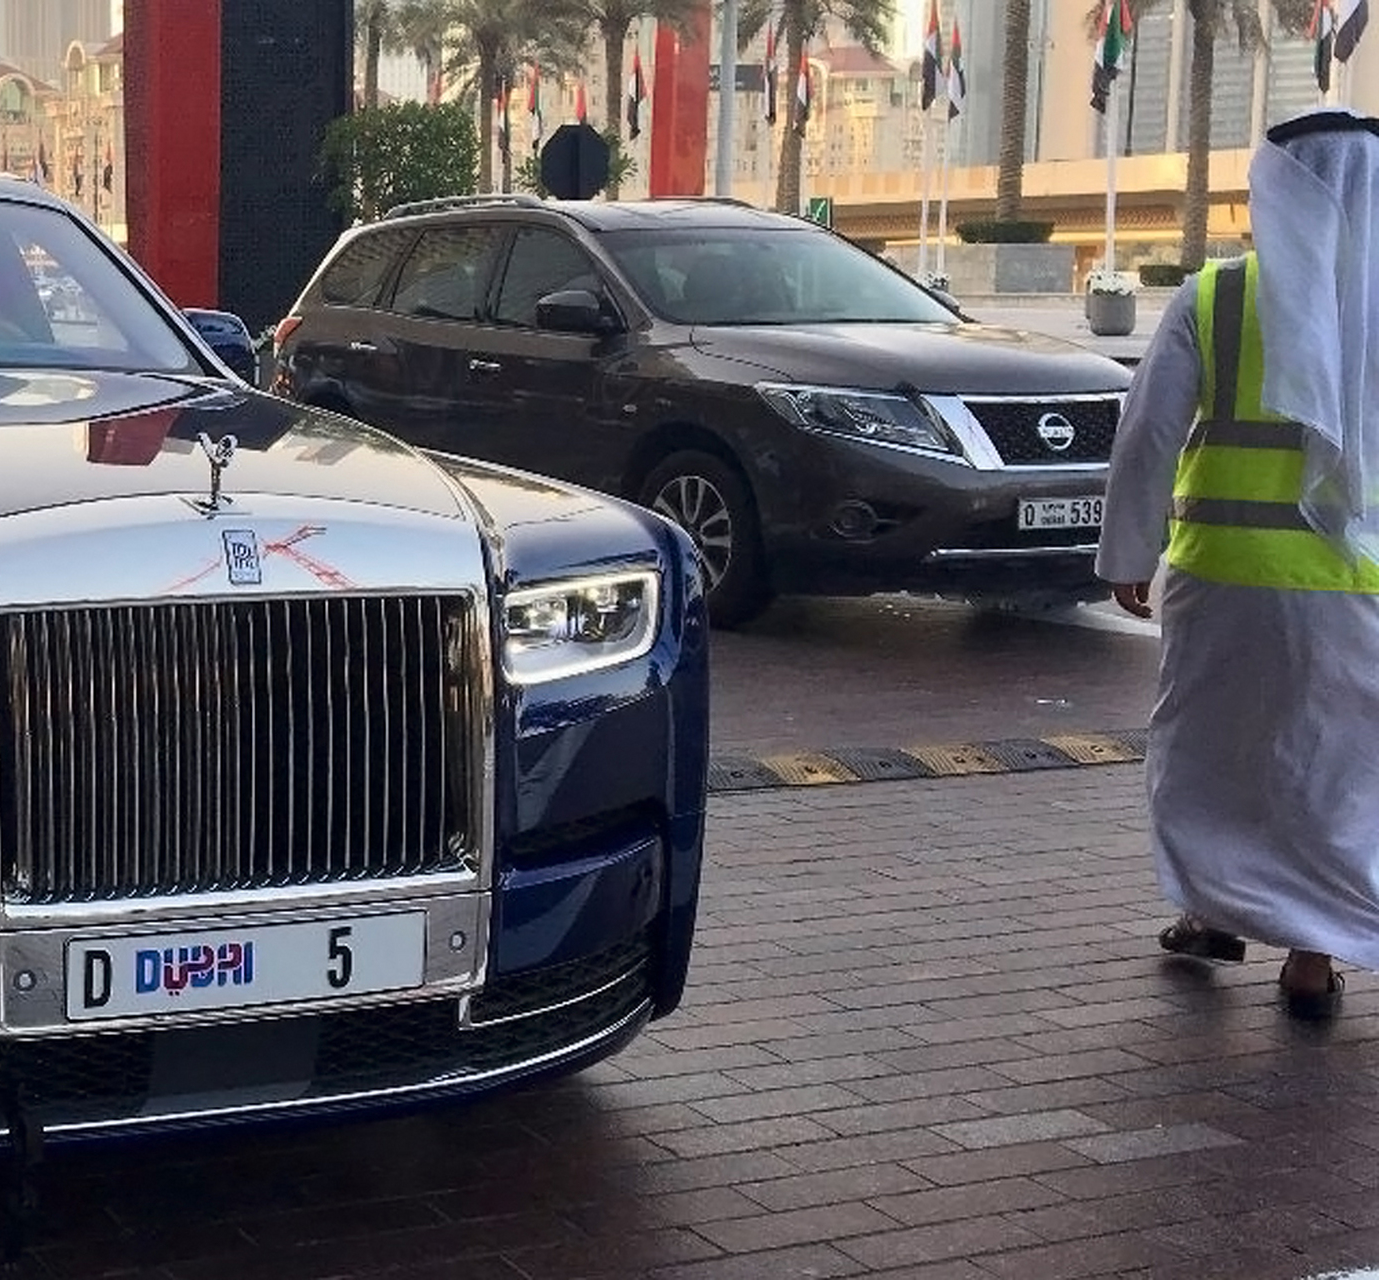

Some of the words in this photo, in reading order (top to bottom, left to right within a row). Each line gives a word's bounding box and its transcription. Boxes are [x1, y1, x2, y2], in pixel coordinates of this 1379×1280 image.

[84, 949, 112, 1009] D
[135, 941, 254, 996] DUBAI
[327, 926, 353, 989] 5
